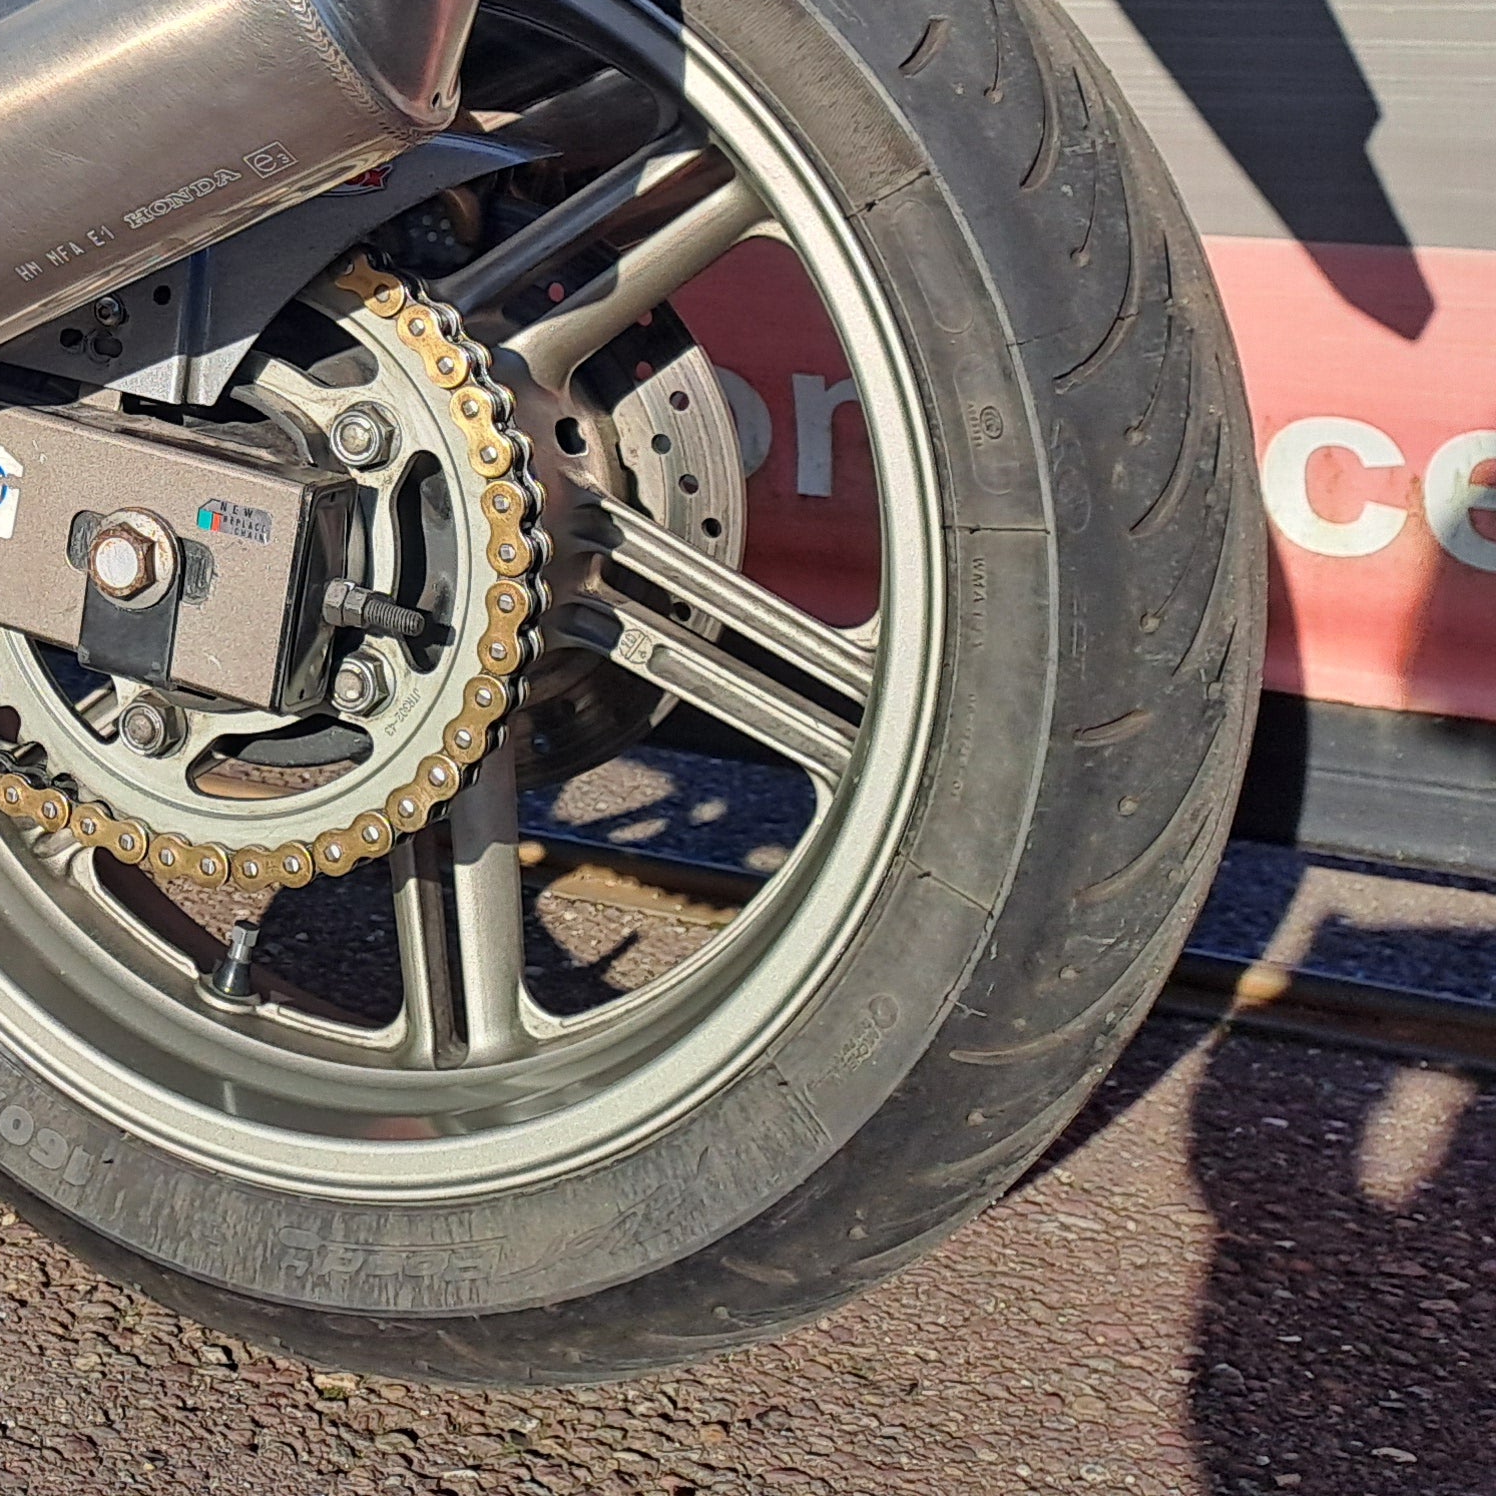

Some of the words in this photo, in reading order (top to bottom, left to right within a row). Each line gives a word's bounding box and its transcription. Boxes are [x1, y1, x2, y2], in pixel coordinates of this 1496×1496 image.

[14, 259, 43, 282] HM
[45, 240, 85, 268] MFA
[86, 225, 116, 248] E1
[123, 168, 242, 230] HONDA
[219, 499, 255, 519] NEW
